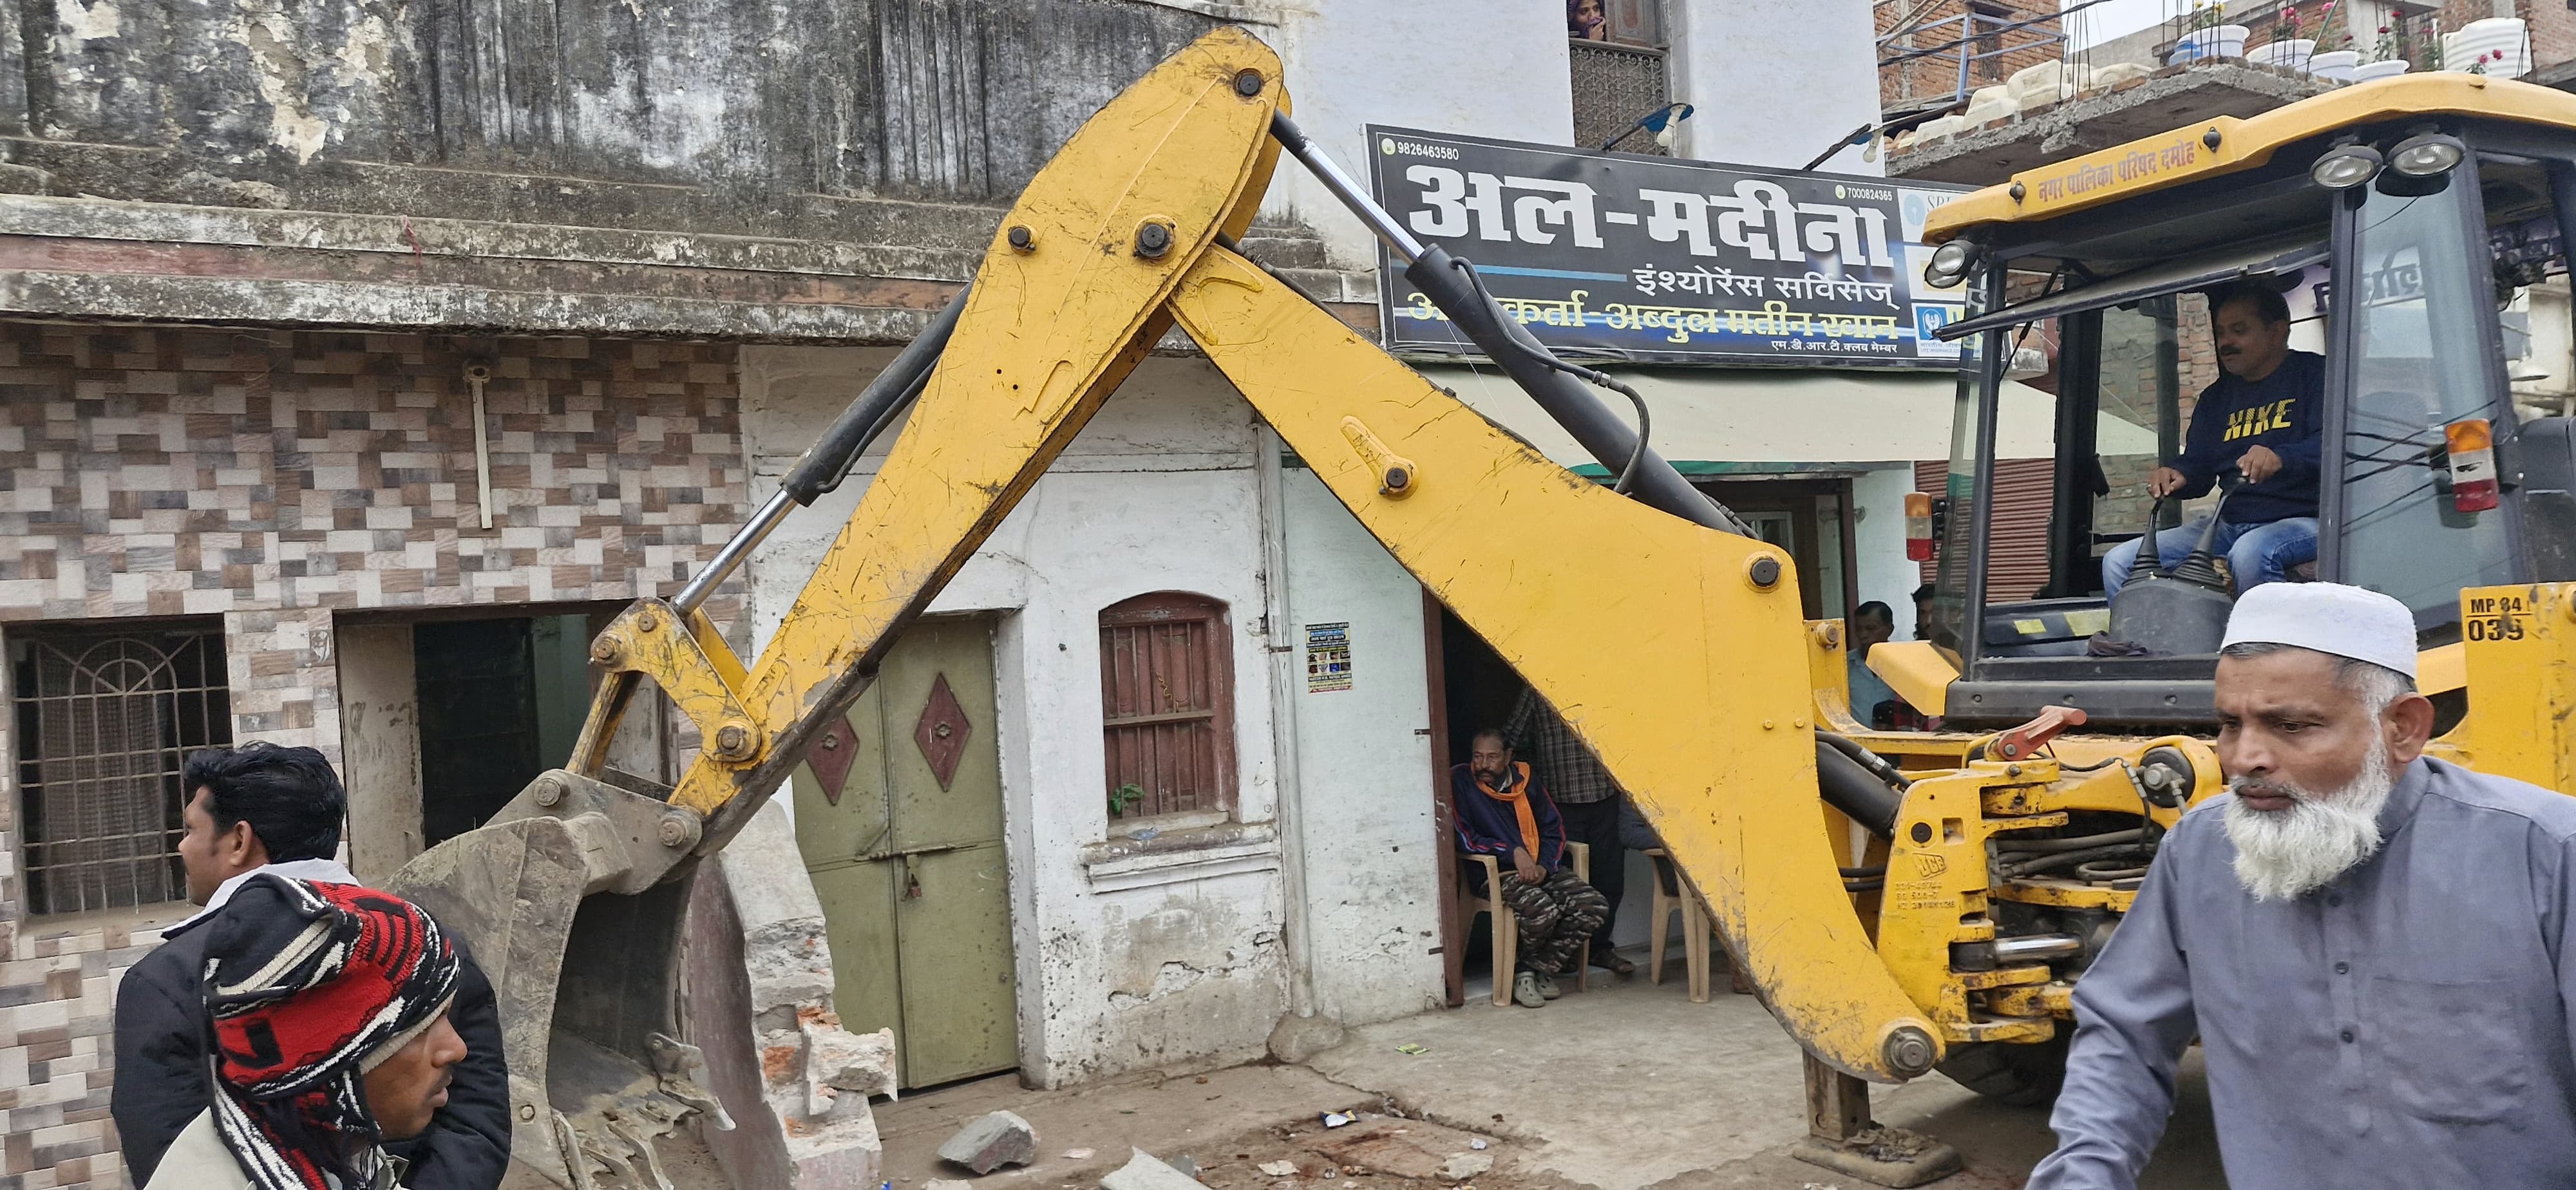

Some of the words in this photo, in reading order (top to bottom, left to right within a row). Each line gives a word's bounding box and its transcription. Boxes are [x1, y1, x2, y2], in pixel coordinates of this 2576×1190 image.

[1397, 141, 1459, 160] 9826463580
[2038, 176, 2063, 202] नगर
[2067, 163, 2115, 194] पालिका
[2118, 151, 2158, 182] परिषद
[2161, 138, 2195, 170] दमोह
[1847, 187, 1893, 202] 7000824365
[1406, 164, 1895, 268] अल-मदीना
[1632, 263, 1765, 298] इंश्योरेंस
[1724, 299, 1815, 337] मतीन
[1817, 313, 1899, 340] खान
[2222, 398, 2297, 442] NIKE
[2470, 598, 2495, 612] MP
[1915, 855, 1946, 878] JCB
